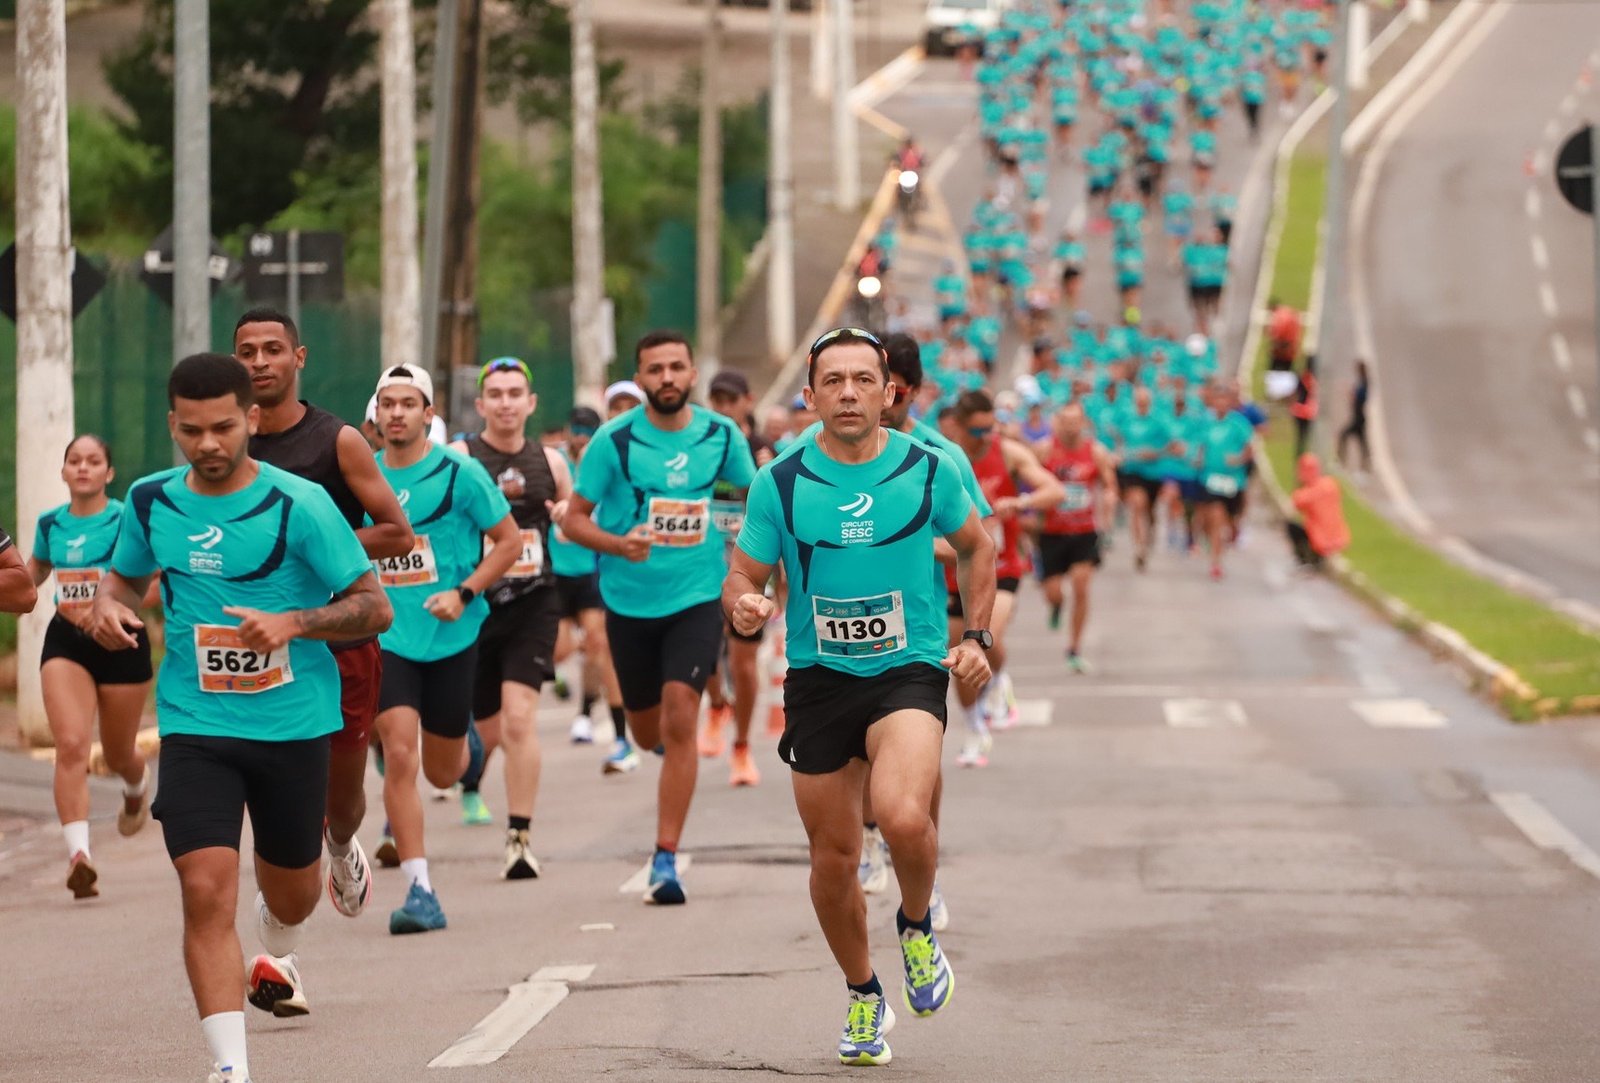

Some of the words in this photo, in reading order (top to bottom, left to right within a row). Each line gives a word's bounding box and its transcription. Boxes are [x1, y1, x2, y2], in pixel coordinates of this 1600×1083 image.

[654, 516, 701, 532] 5644
[841, 528, 873, 538] SESC
[189, 558, 223, 569] SESC
[826, 618, 886, 640] 1130
